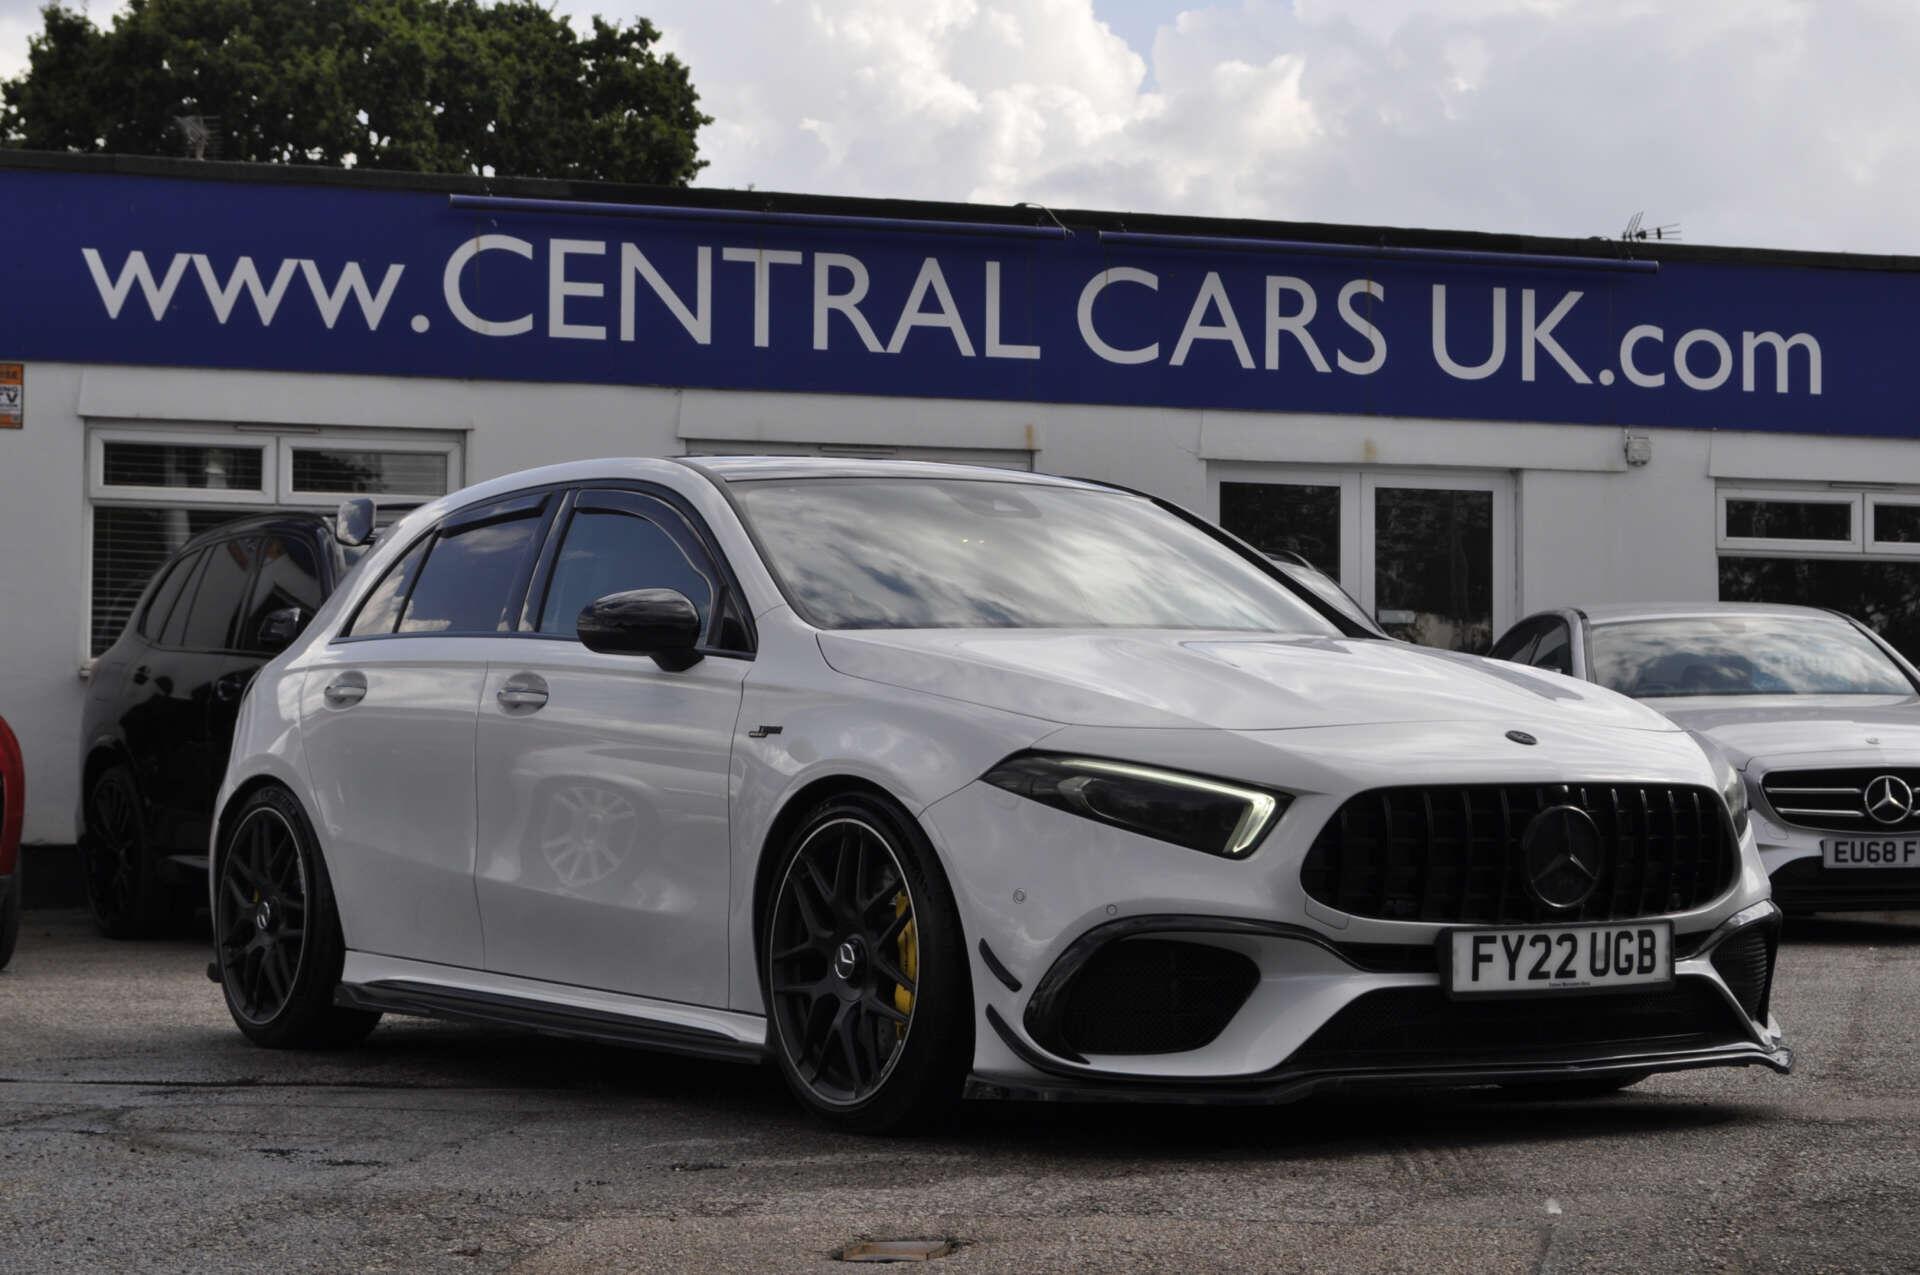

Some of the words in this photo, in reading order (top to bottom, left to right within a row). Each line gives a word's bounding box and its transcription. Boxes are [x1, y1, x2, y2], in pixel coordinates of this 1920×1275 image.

[81, 234, 1041, 360] www.CENTRAL
[1077, 267, 1387, 377] CARS
[1432, 284, 1822, 395] UK.com
[1834, 840, 1897, 864] EU68
[1903, 840, 1920, 864] F
[1471, 932, 1580, 982] FY22
[1589, 928, 1657, 978] UGB
